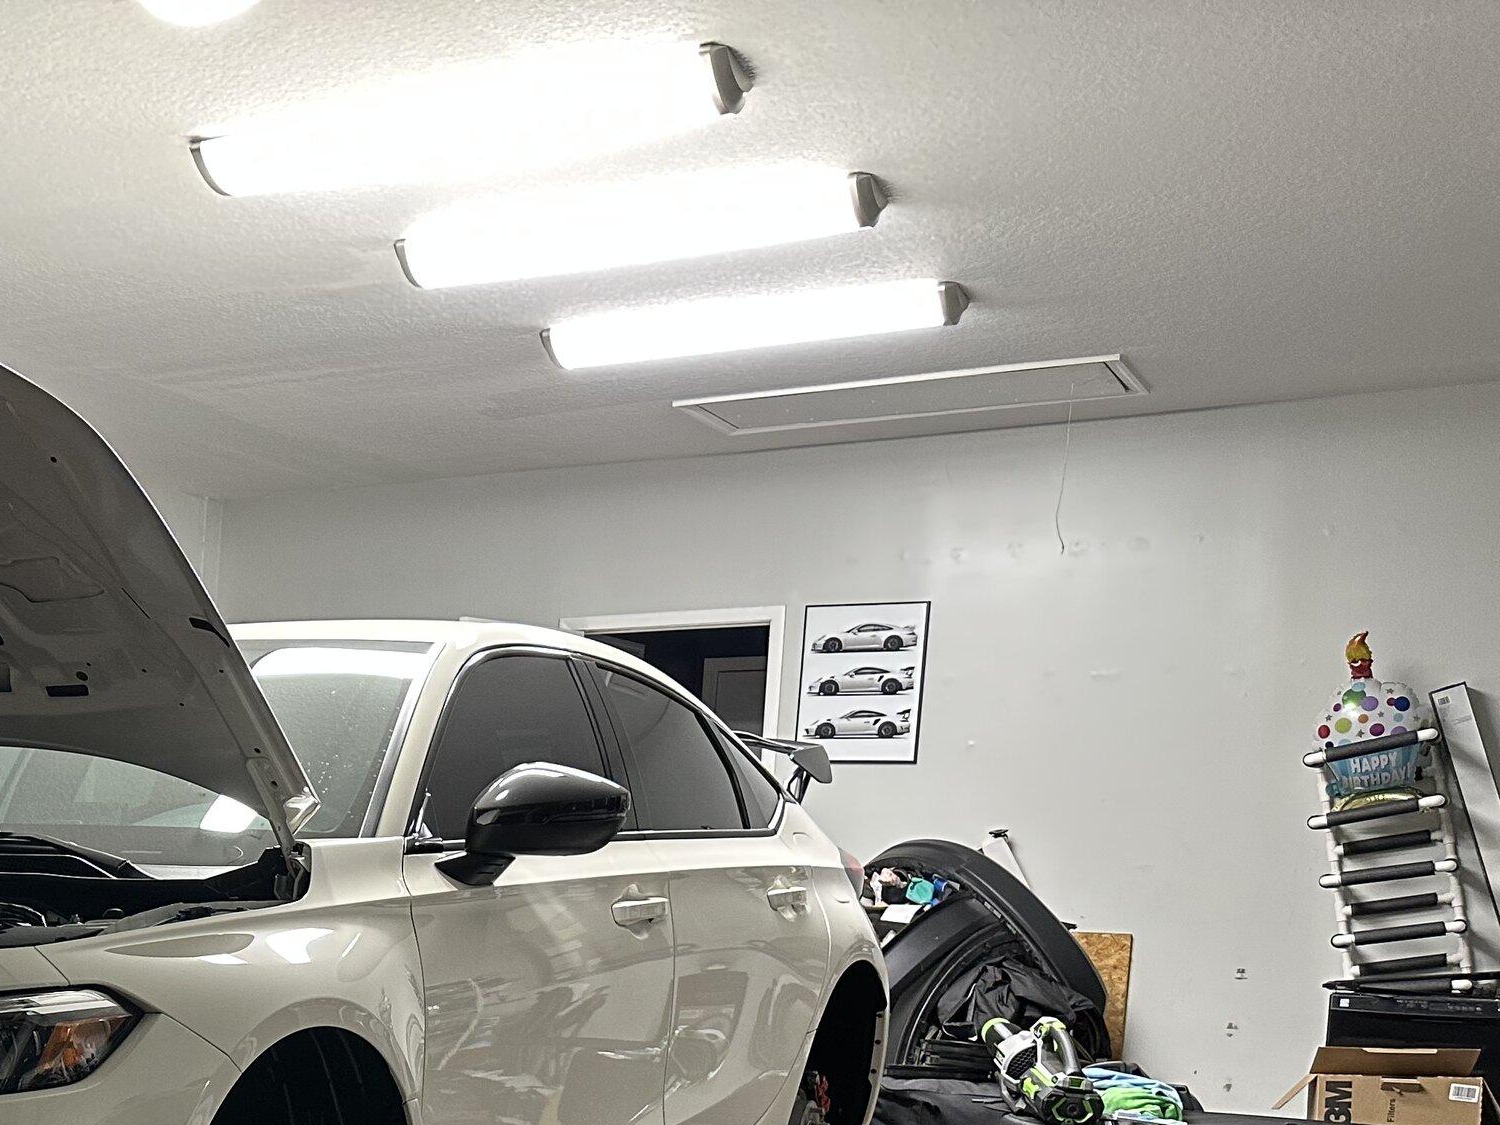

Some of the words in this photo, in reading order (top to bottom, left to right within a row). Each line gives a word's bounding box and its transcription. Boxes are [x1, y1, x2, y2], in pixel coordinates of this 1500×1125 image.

[1350, 752, 1398, 773] HAPPY
[1324, 1081, 1352, 1124] 3M
[1387, 1098, 1396, 1122] Filters
